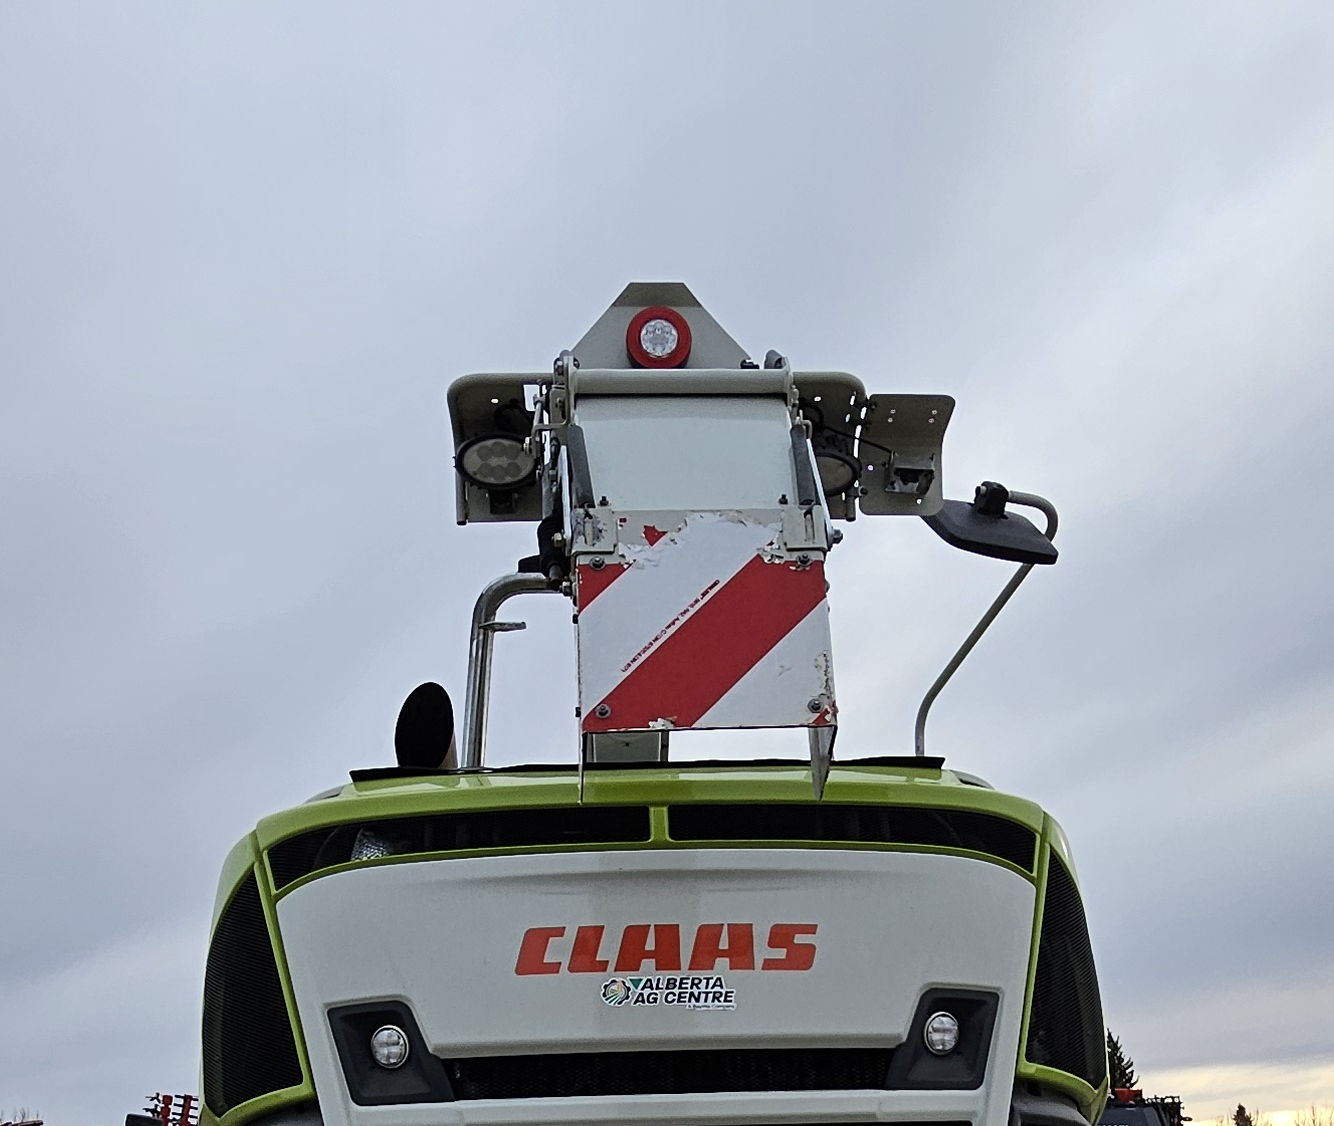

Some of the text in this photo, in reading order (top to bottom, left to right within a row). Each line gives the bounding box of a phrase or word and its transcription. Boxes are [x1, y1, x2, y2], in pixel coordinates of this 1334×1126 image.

[515, 923, 818, 976] CLAAS
[640, 977, 724, 991] ALBERTA
[633, 991, 735, 1005] AG CENTRE
